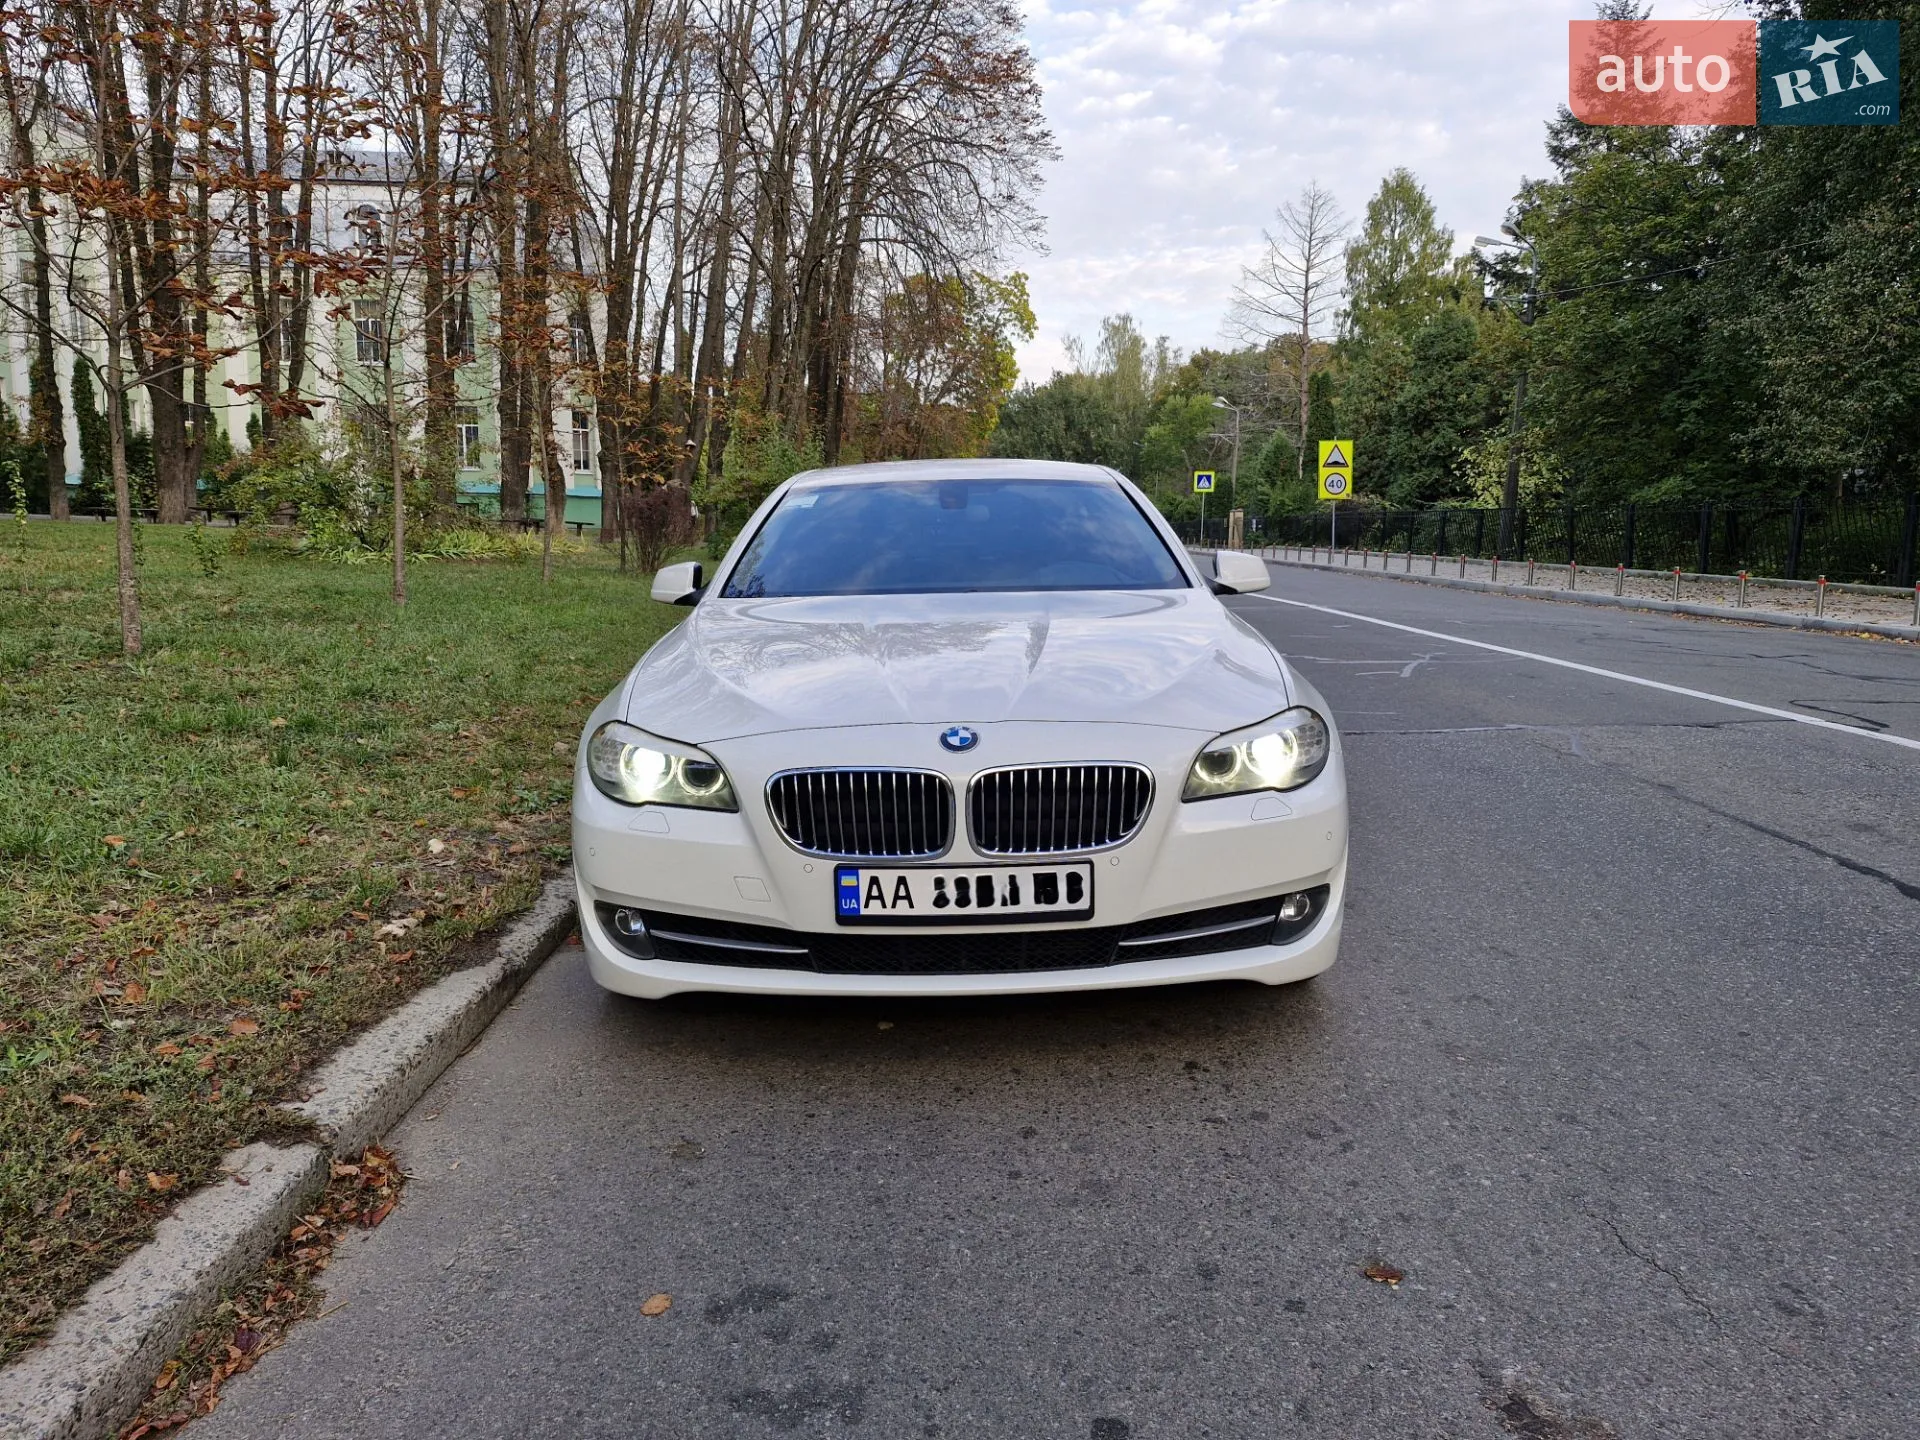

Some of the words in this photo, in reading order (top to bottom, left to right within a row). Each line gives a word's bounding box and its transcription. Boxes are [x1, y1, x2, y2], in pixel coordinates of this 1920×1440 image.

[1328, 479, 1343, 488] 40
[863, 875, 915, 909] AA
[842, 898, 858, 909] UA
